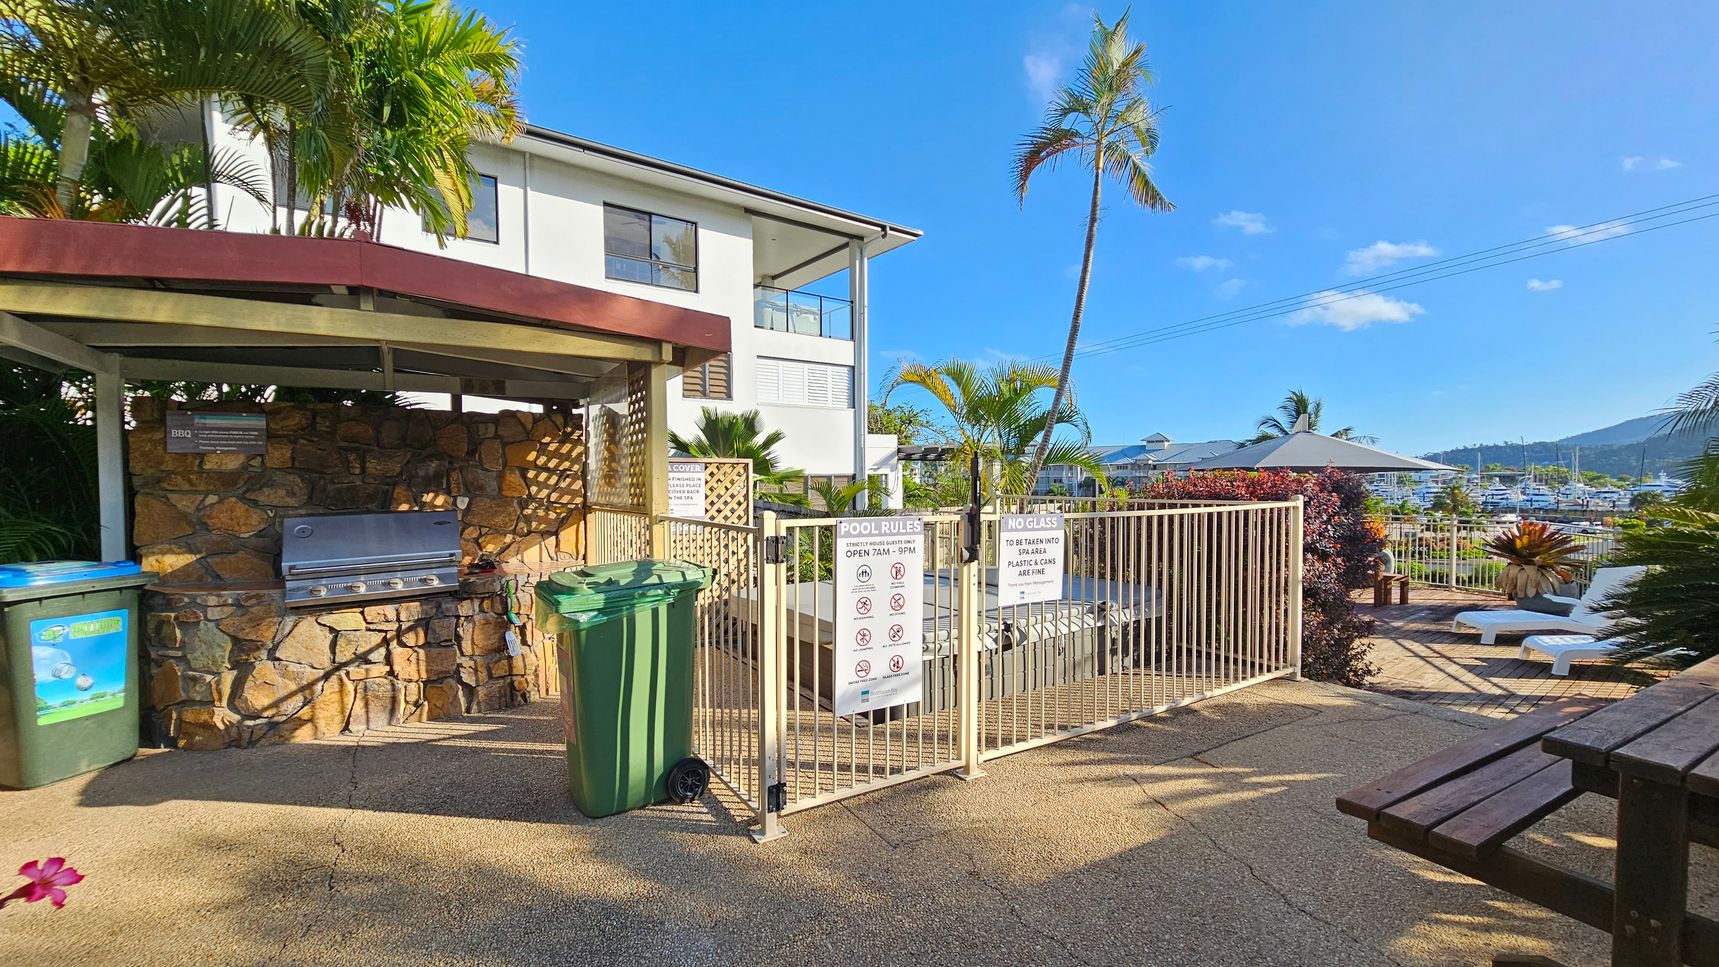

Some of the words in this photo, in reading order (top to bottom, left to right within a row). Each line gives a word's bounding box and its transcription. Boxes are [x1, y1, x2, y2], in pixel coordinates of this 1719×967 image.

[840, 522, 878, 535] POOL
[882, 520, 921, 534] RULES
[1008, 518, 1024, 529] NO
[1026, 517, 1057, 529] GLASS
[846, 549, 869, 558] OPEN
[872, 548, 890, 556] 7AM
[898, 546, 916, 555] 9PM
